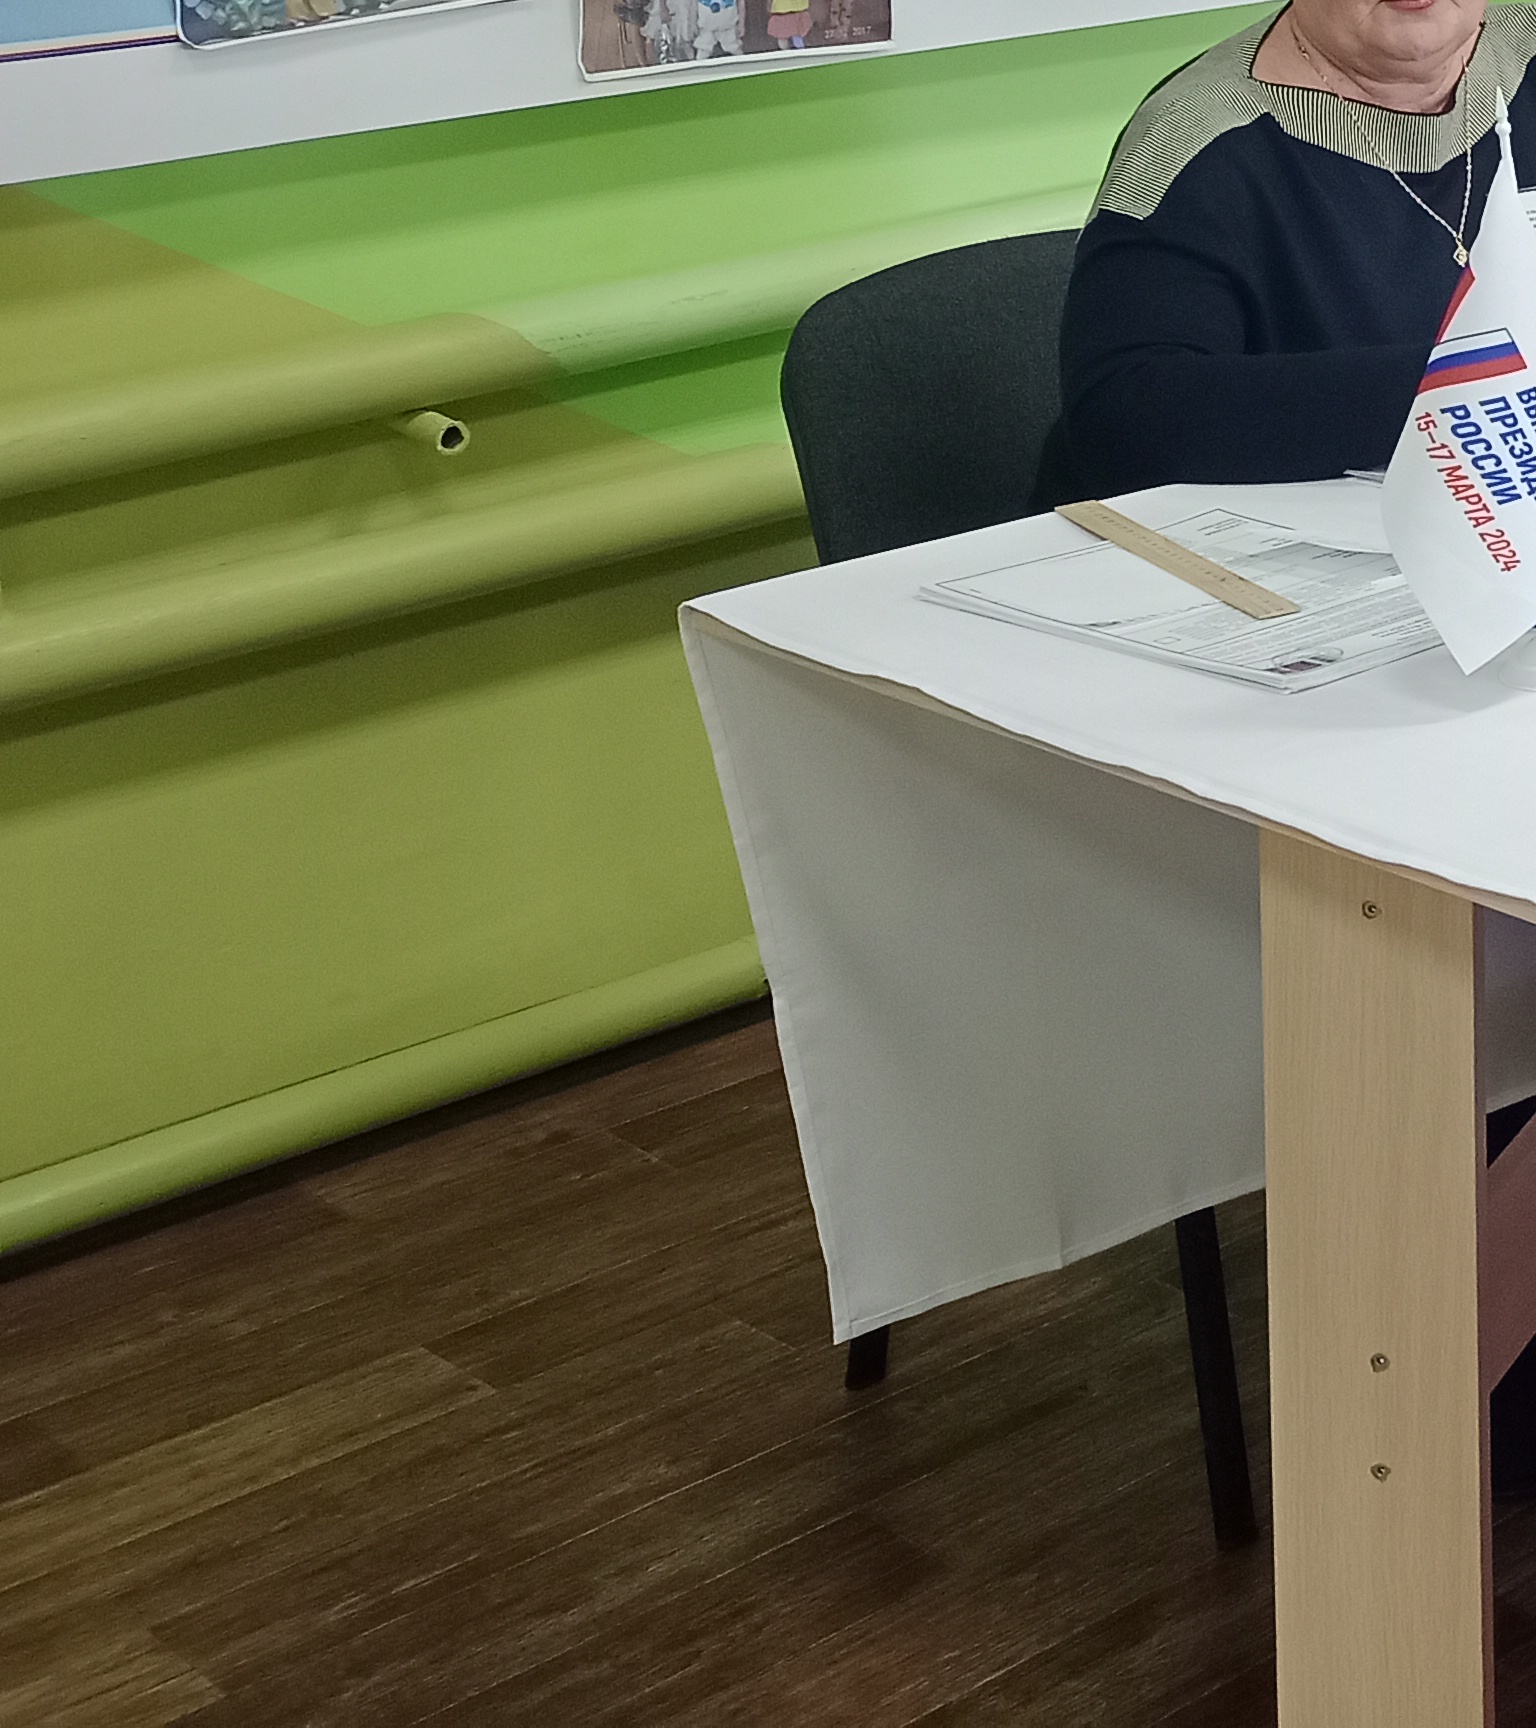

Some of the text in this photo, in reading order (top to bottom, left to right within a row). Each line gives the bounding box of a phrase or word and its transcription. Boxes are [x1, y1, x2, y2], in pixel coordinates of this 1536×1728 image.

[1439, 403, 1523, 506] РОССИИ
[1437, 464, 1496, 529] МАРТА
[1478, 528, 1521, 573] 2024
